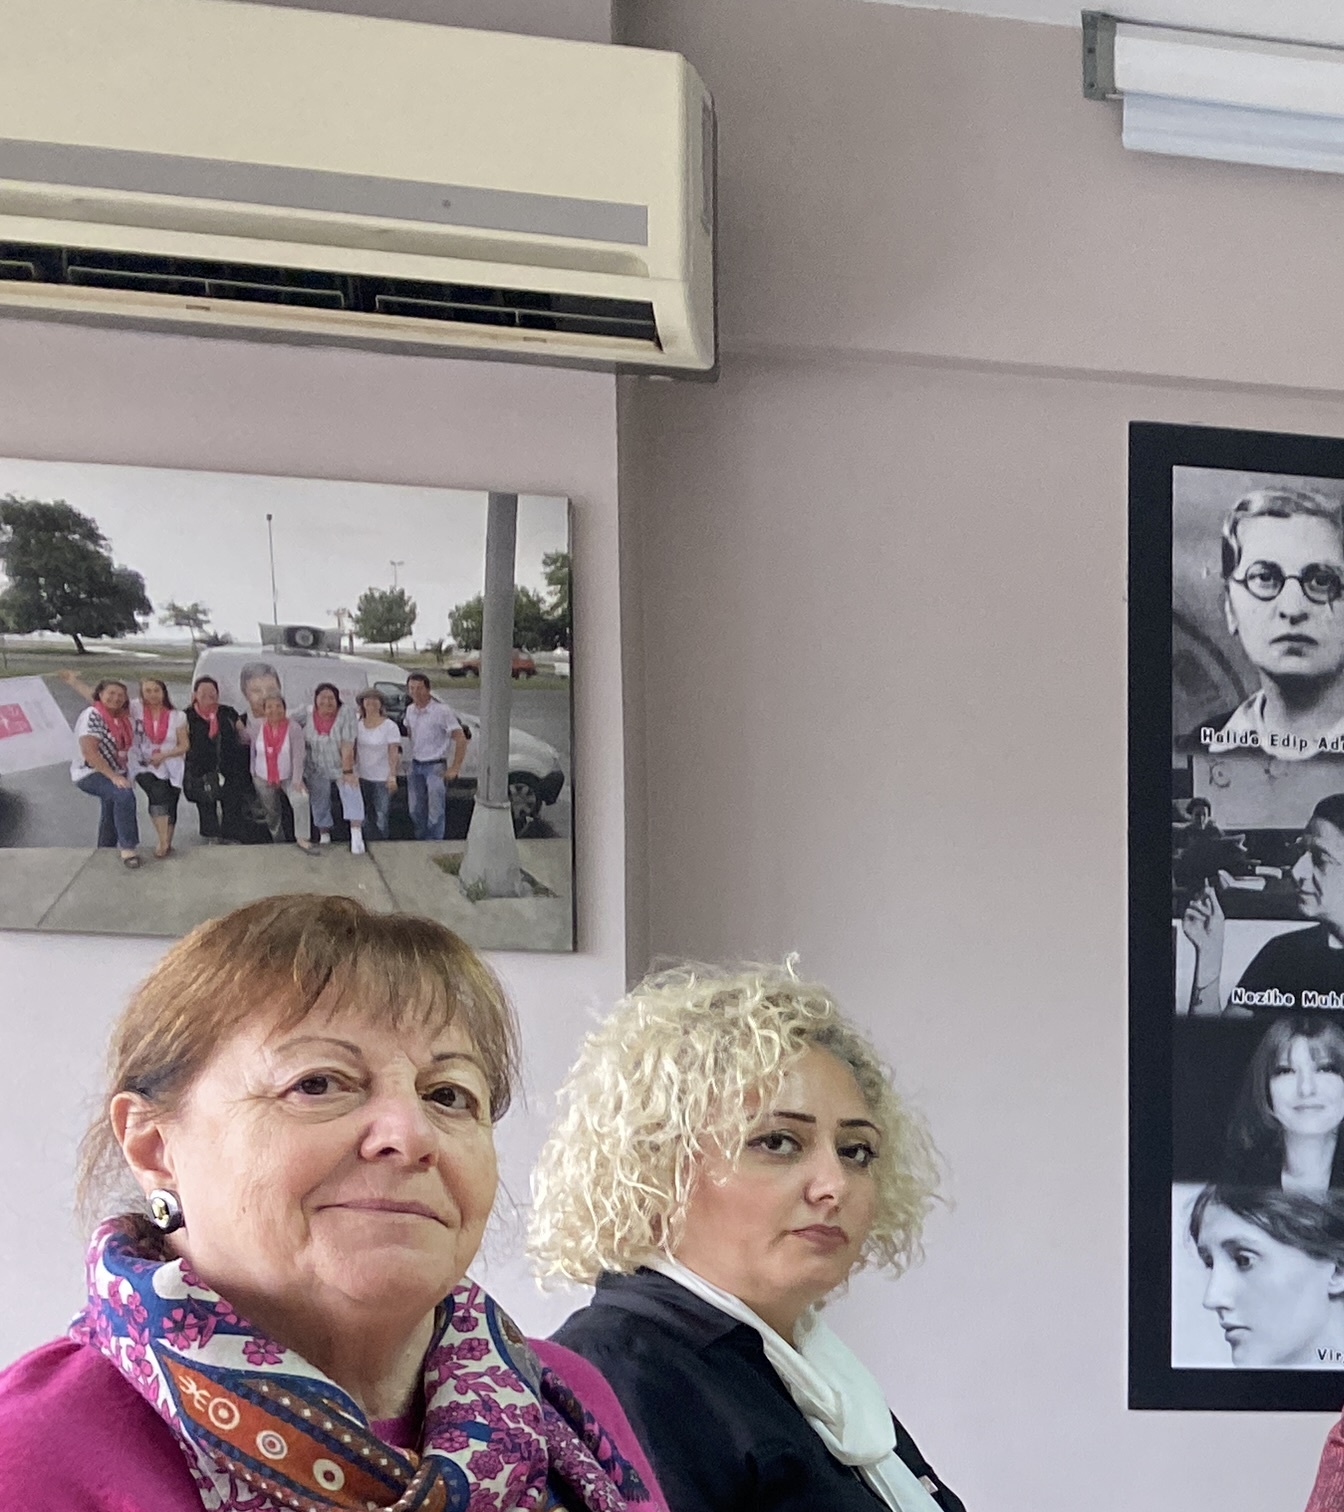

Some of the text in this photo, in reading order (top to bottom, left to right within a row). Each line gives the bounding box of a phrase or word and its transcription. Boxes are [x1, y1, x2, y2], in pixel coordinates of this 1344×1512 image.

[1202, 728, 1260, 746] Halide
[1270, 733, 1308, 751] Edip
[1231, 987, 1295, 1007] Nezihe
